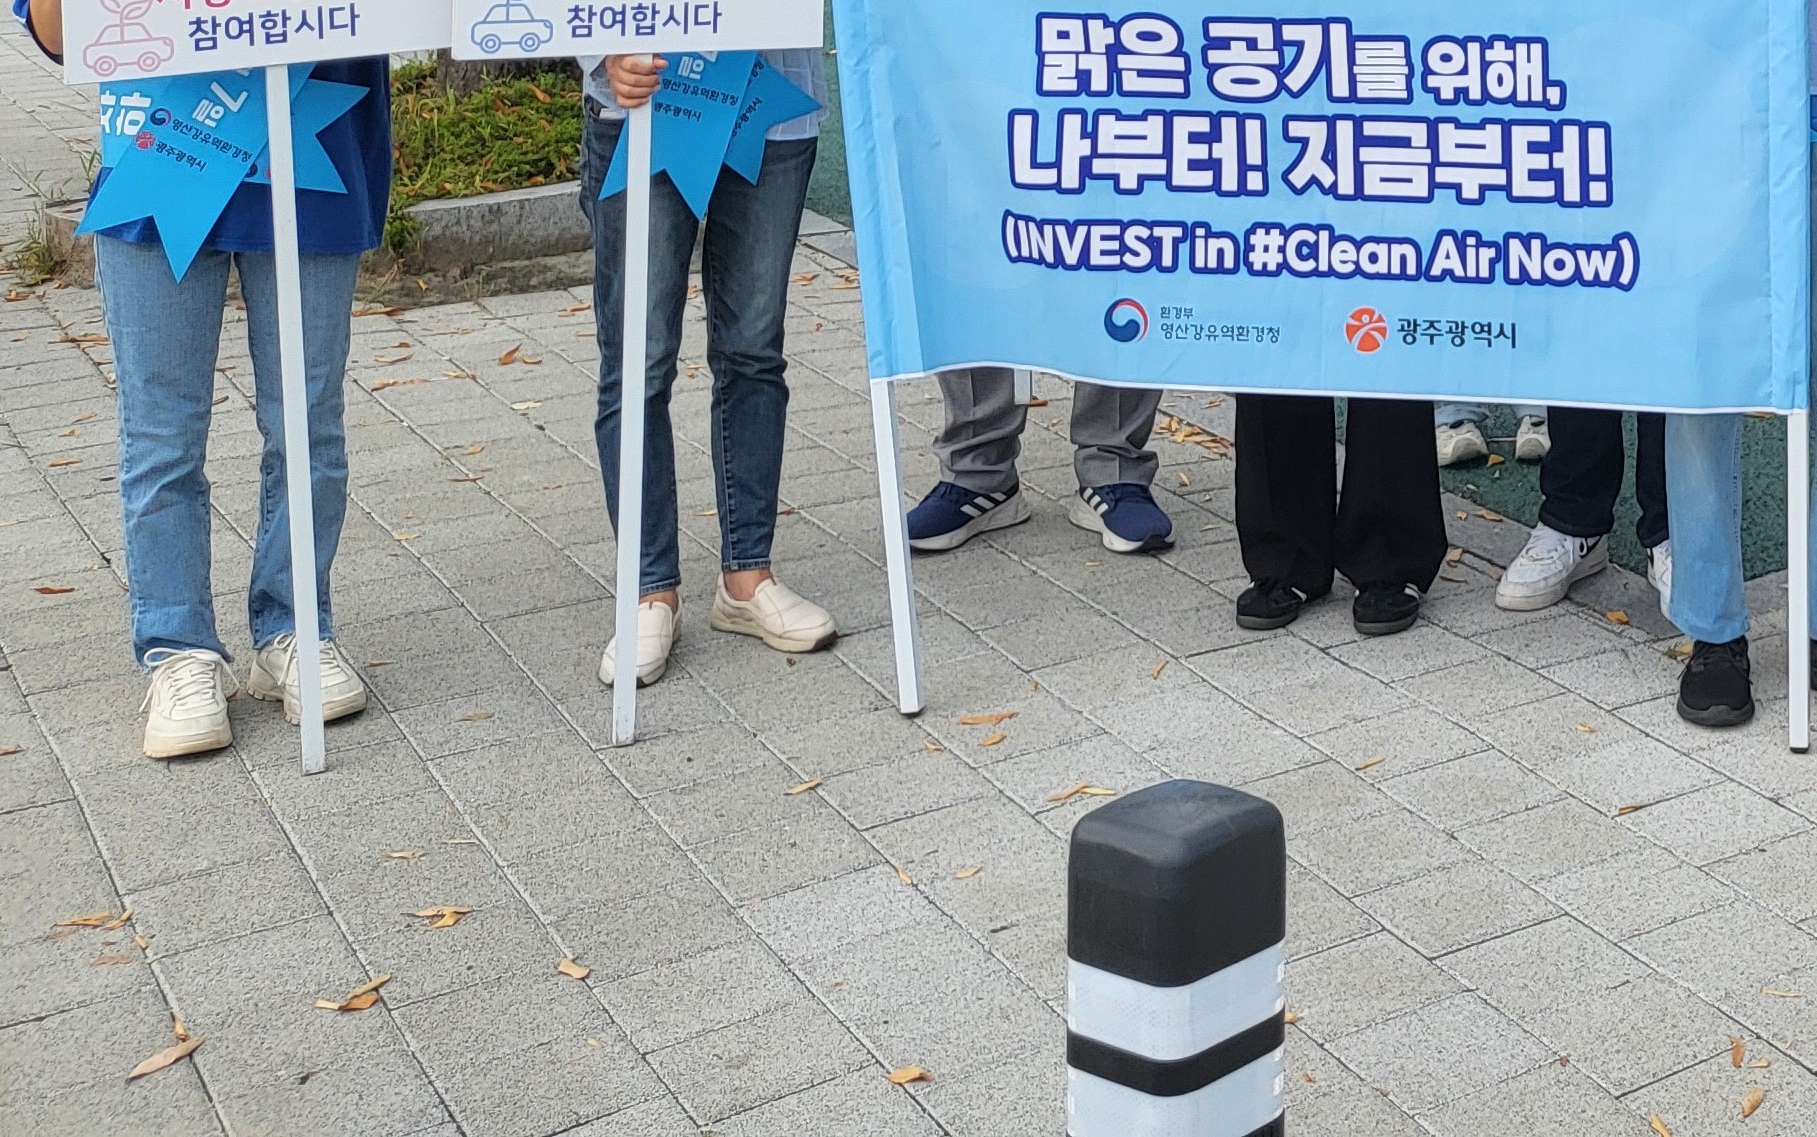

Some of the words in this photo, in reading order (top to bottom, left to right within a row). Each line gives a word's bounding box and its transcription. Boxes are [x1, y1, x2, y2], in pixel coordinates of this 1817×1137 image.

[188, 3, 361, 52] 참여합시다
[566, 0, 723, 39] 참여합시다
[1039, 16, 1187, 95] 맑은
[1205, 20, 1411, 100] 공기를
[1425, 39, 1563, 107] 위해,
[155, 139, 208, 172] 광주광역시
[171, 117, 253, 163] 영산강유역환경청
[1011, 112, 1265, 193] 나부터!
[1286, 118, 1609, 204] 지금부터!
[1004, 213, 1185, 269] (INVEST
[1193, 225, 1237, 270] in
[1246, 226, 1419, 277] #Clean
[1428, 233, 1498, 280] Air
[1507, 236, 1636, 287] Now)
[1159, 306, 1194, 320] 환경부
[1160, 322, 1281, 344] 영산강유역환경청
[1396, 318, 1517, 349] 광주광역시
